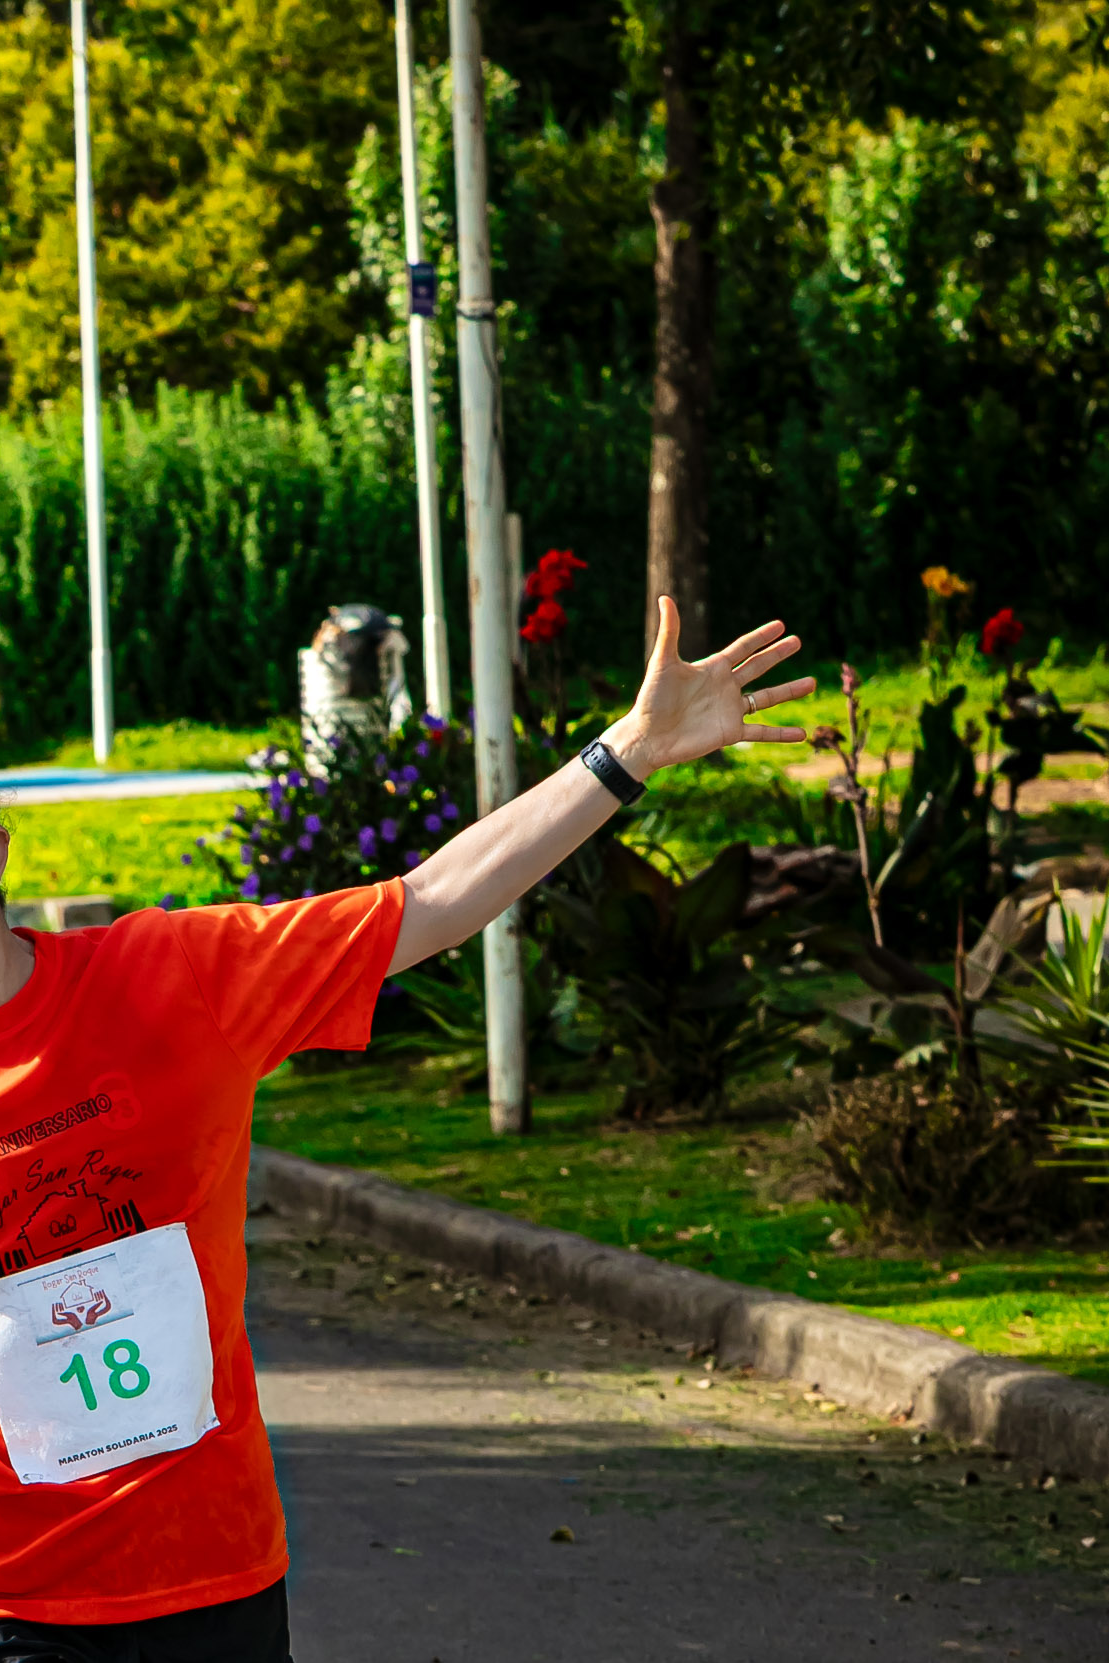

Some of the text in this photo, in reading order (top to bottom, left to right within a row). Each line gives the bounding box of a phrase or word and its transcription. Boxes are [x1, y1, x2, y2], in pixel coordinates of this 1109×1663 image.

[25, 1158, 68, 1192] San
[78, 1149, 143, 1189] Roque
[64, 1273, 78, 1284] San
[77, 1266, 99, 1279] Roque
[59, 1338, 151, 1412] 18
[58, 1423, 179, 1466] MARATON SOLIDARIA 2025
